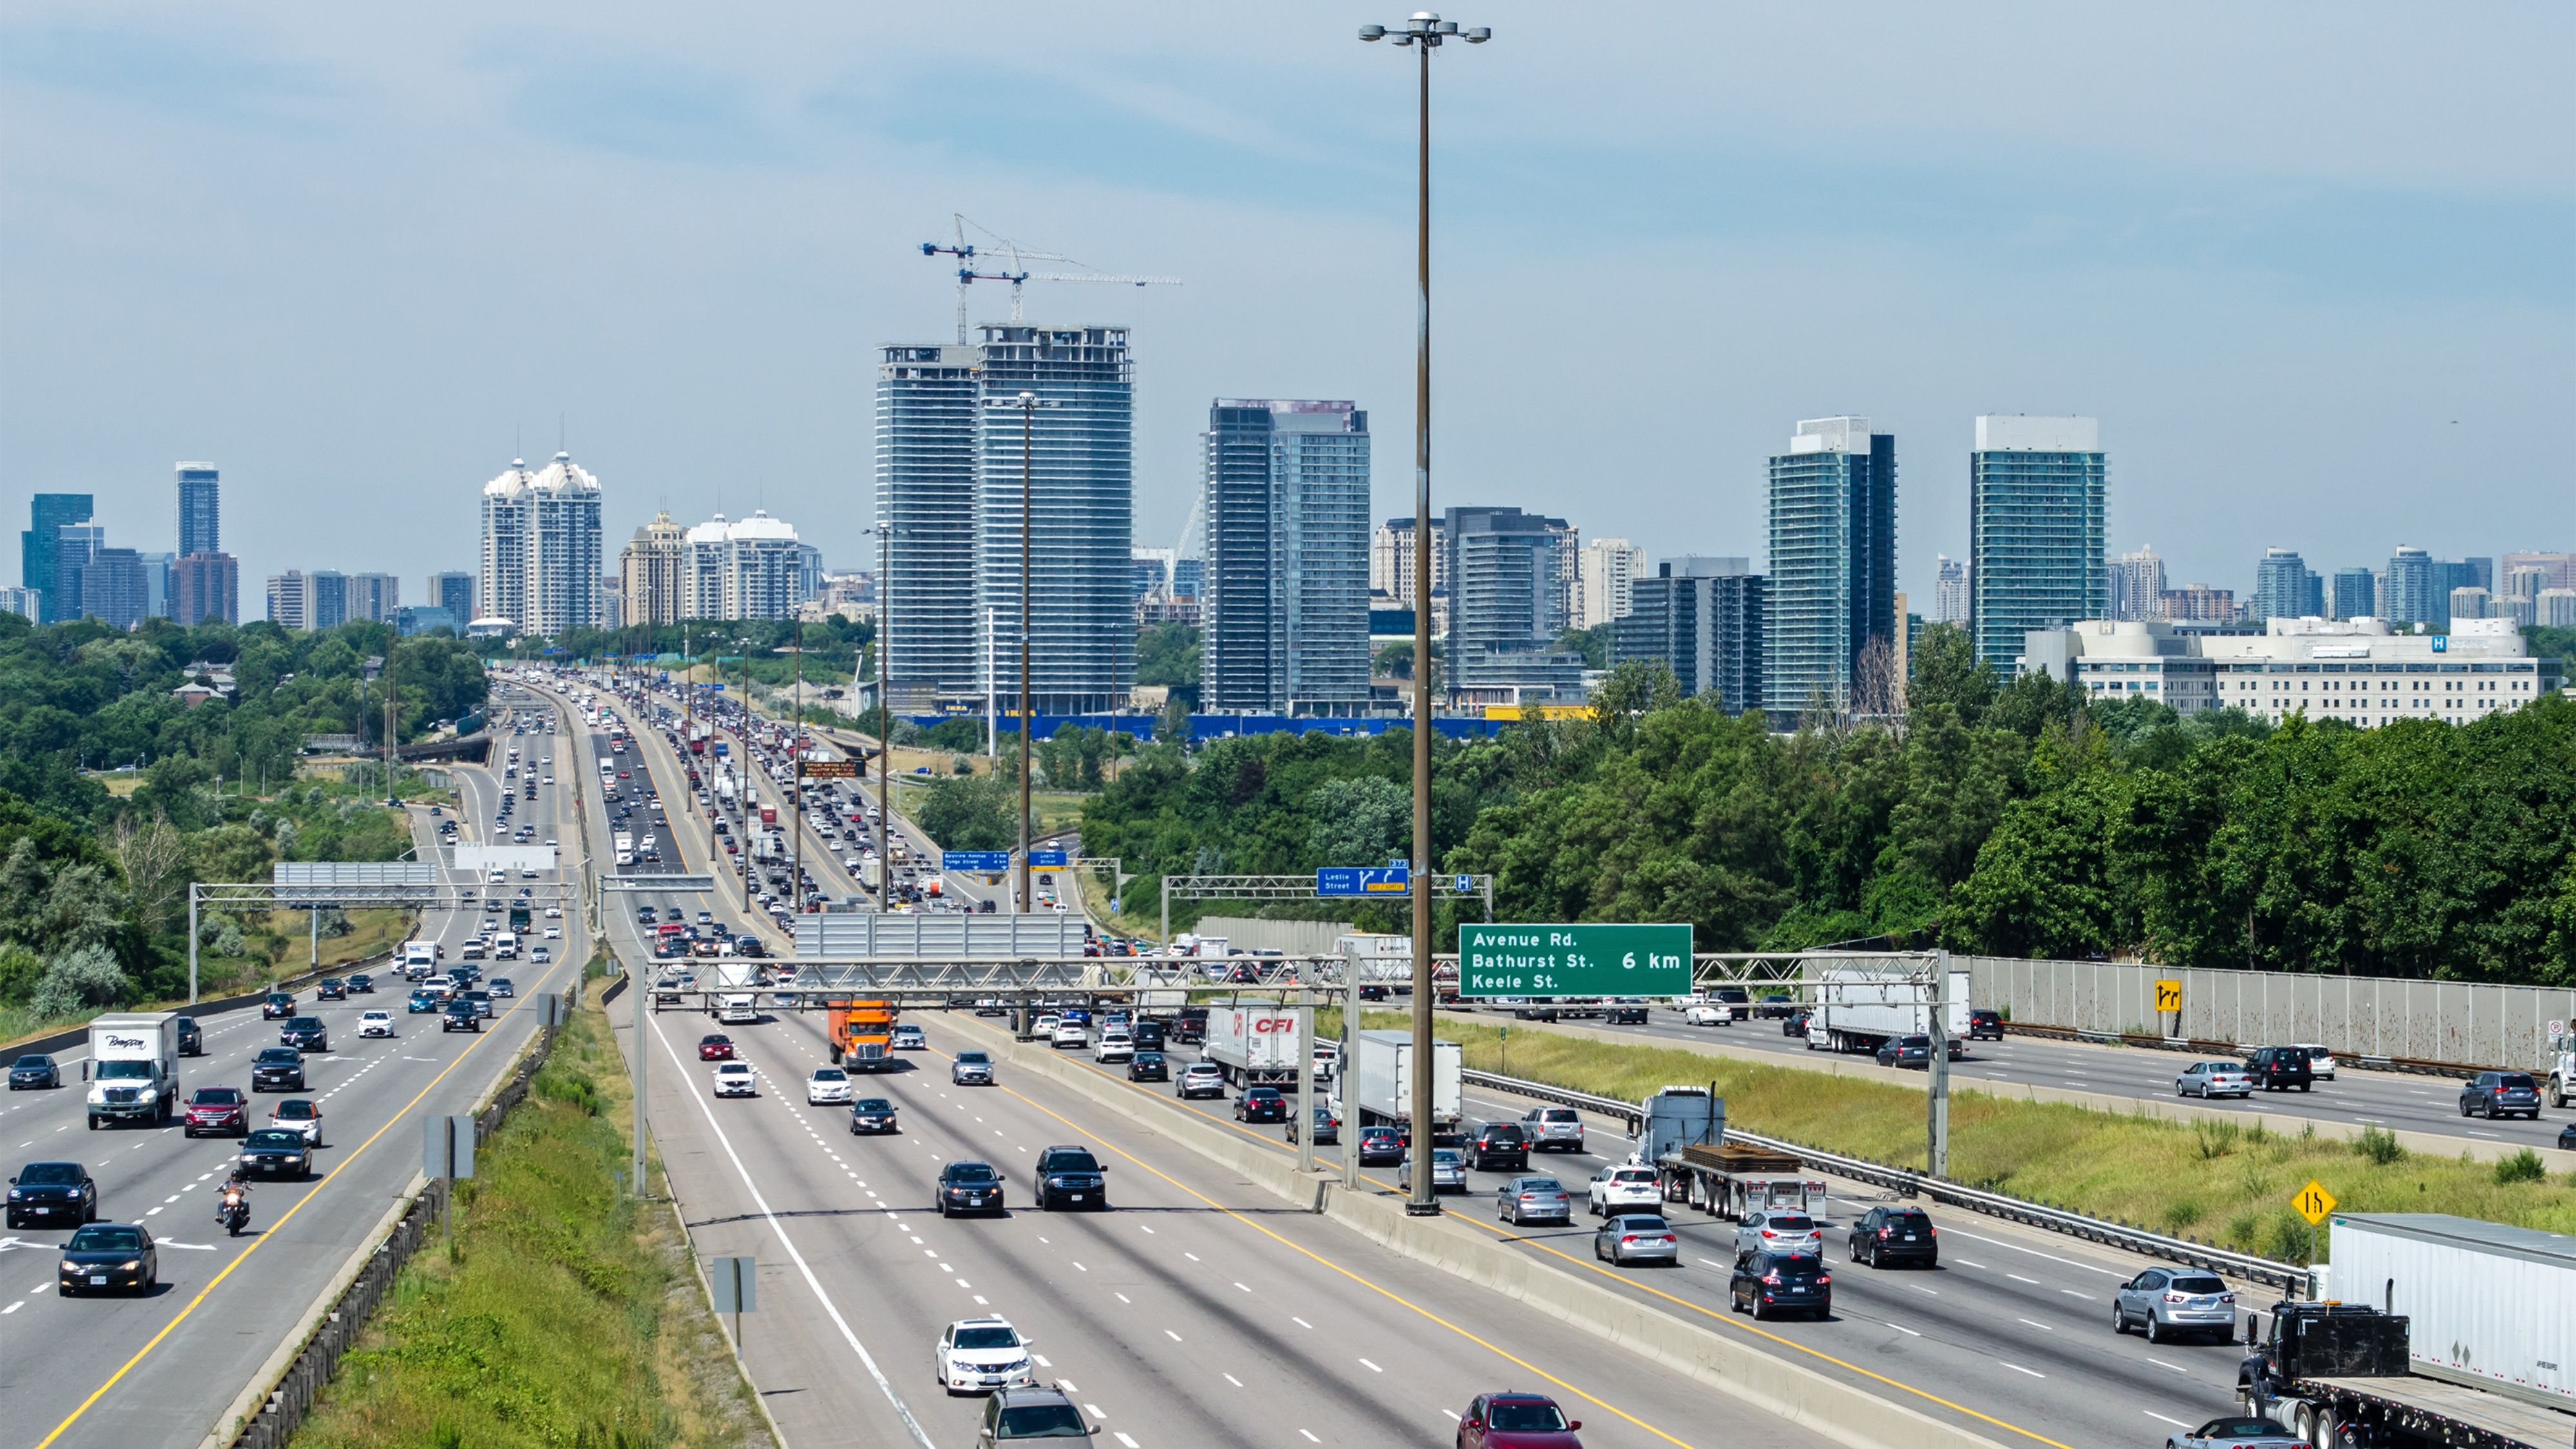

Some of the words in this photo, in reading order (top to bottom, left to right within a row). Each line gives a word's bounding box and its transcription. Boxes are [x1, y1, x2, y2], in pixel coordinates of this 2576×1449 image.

[2434, 638, 2443, 648] H
[1458, 876, 1468, 889] H
[1473, 933, 1540, 946] Avenue
[1550, 933, 1577, 946] Rd.
[1473, 954, 1555, 967] Bathurst
[1566, 954, 1594, 967] St.
[1622, 952, 1636, 969] 6
[1649, 952, 1680, 969] km
[1472, 974, 1522, 988] Keele
[1533, 974, 1558, 988] St.
[1256, 1019, 1294, 1033] CFI
